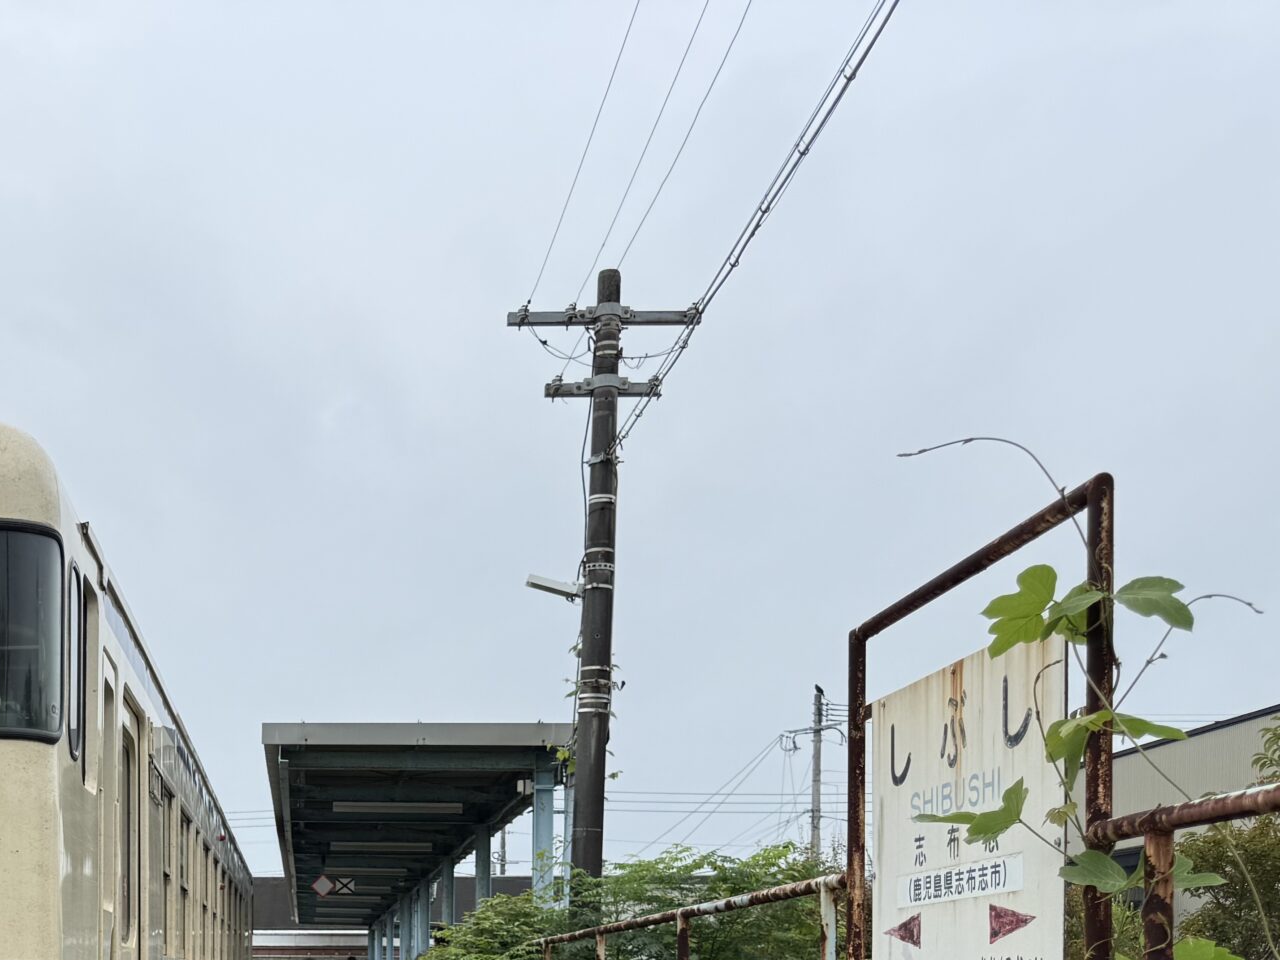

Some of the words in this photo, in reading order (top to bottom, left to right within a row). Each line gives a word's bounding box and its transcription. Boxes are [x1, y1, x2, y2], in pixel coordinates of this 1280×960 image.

[890, 674, 1033, 787] しぶし
[910, 766, 1001, 823] SHIBUSHI
